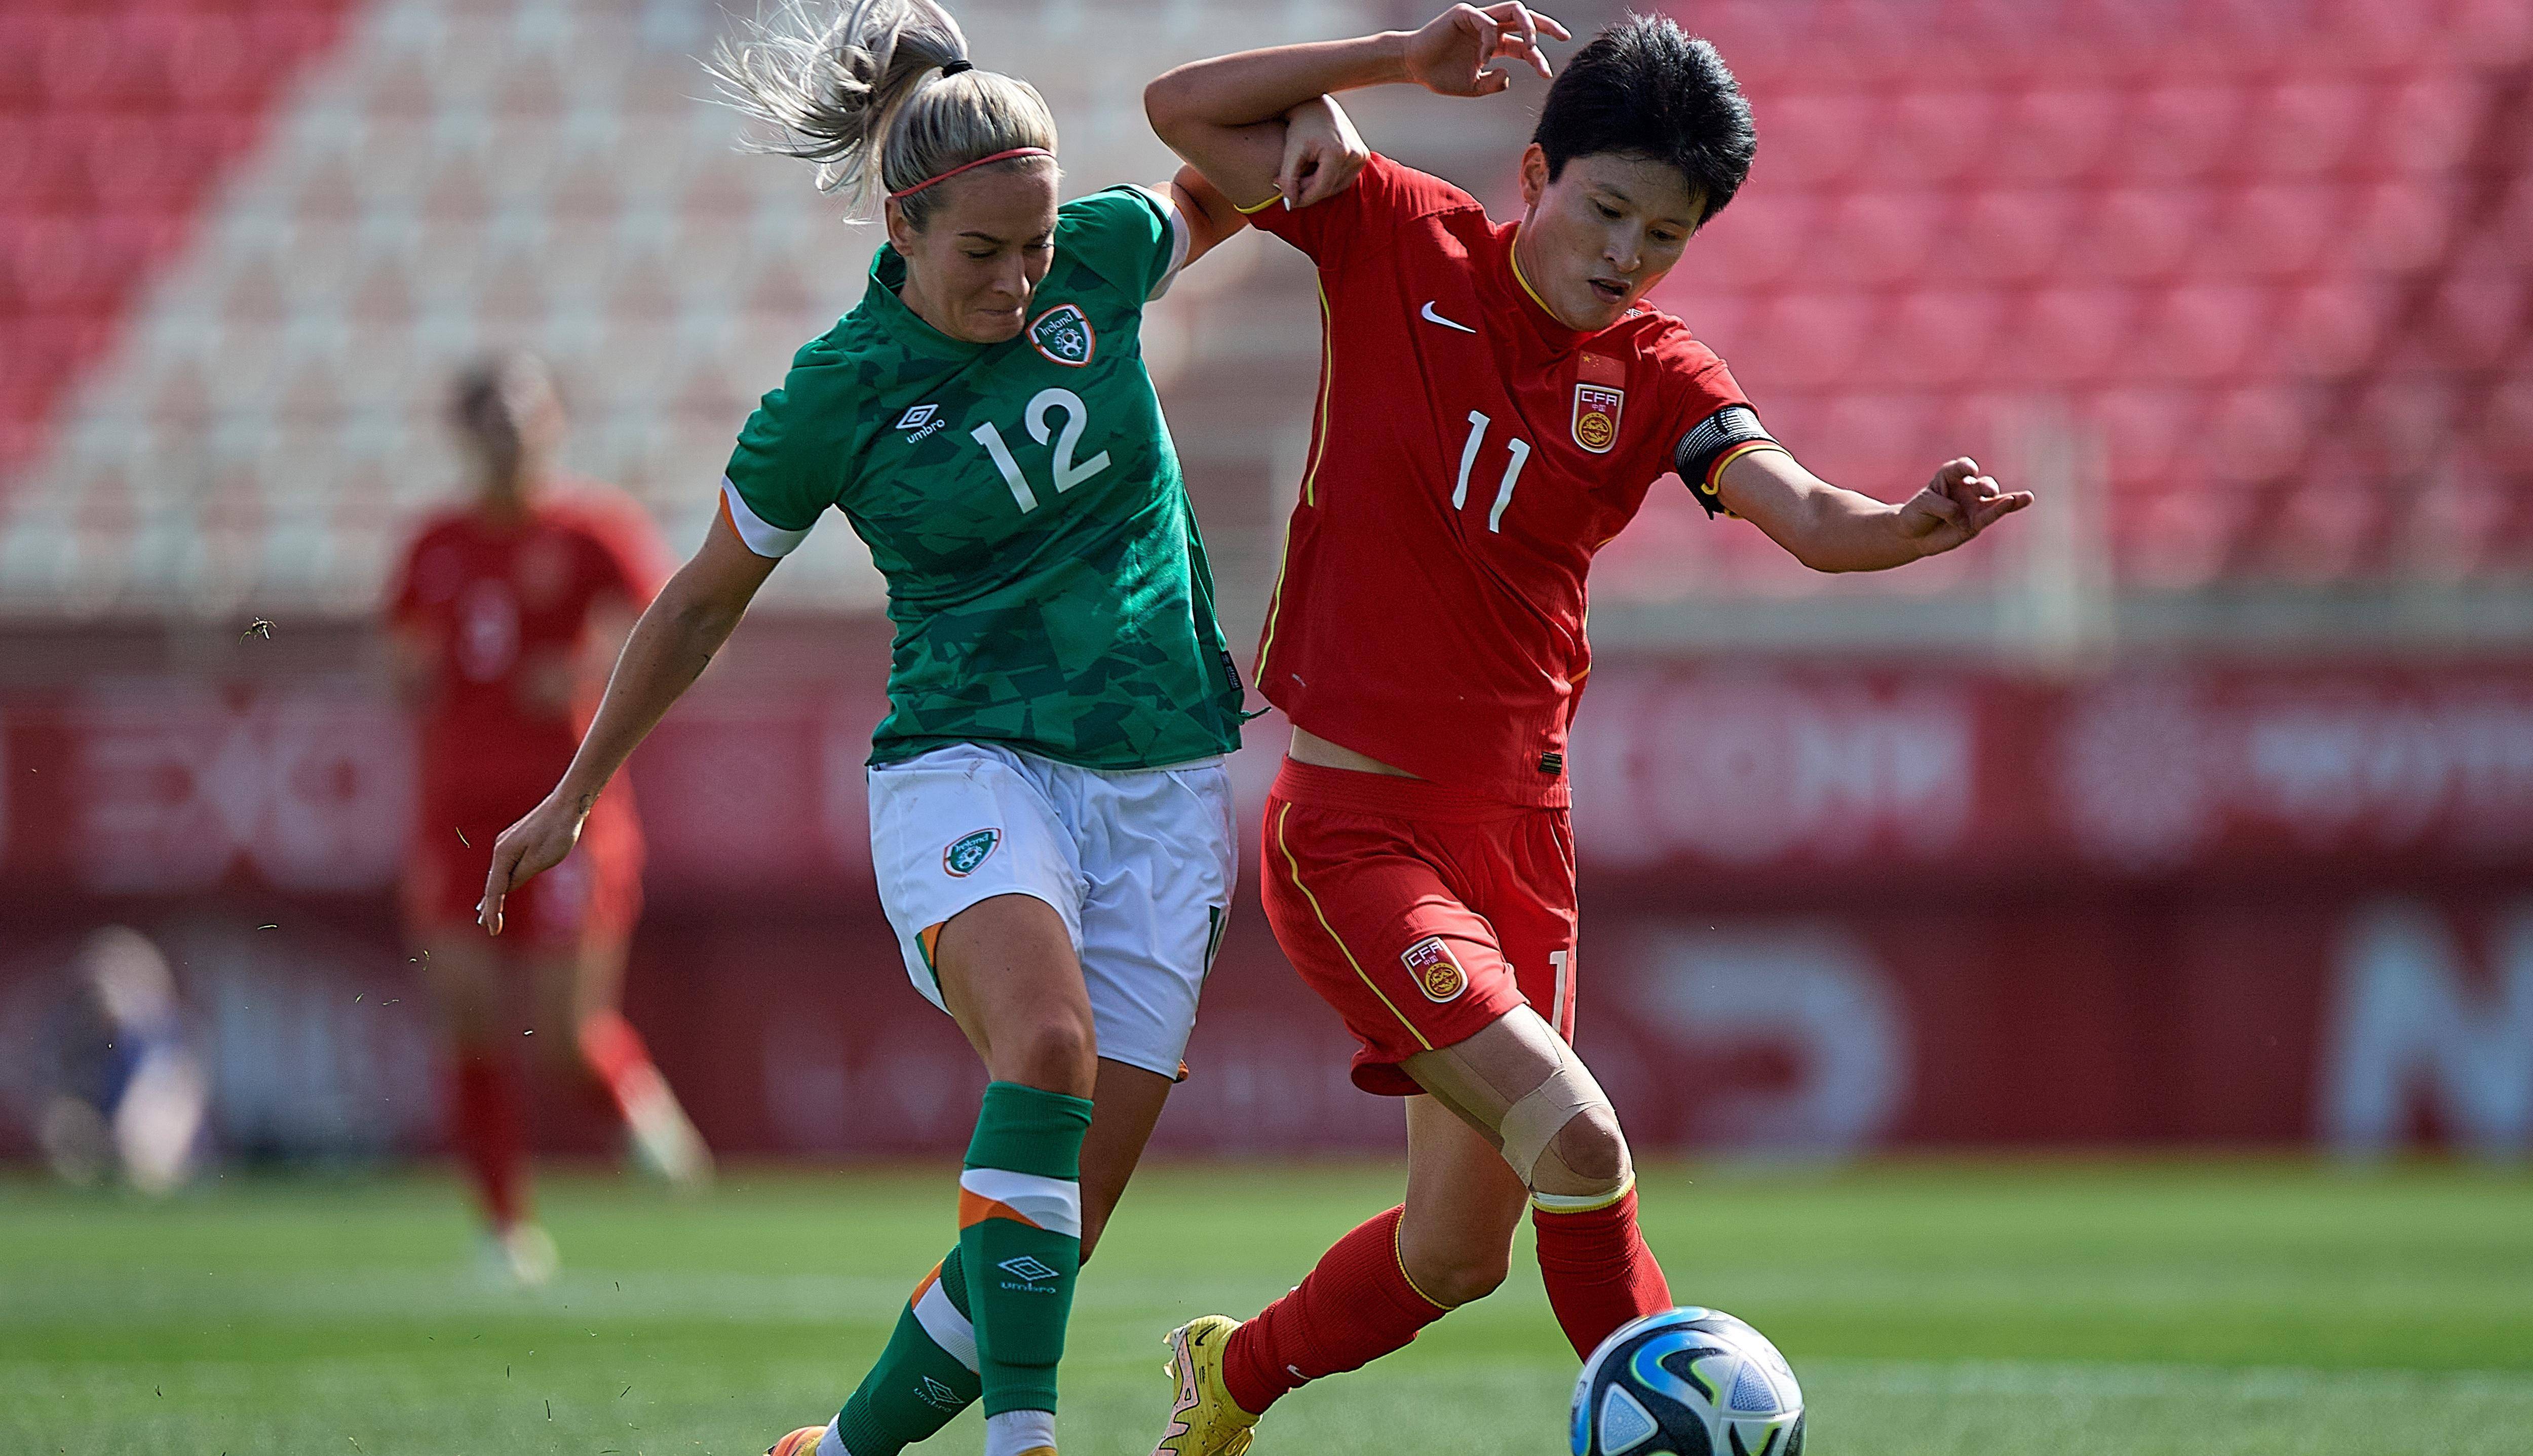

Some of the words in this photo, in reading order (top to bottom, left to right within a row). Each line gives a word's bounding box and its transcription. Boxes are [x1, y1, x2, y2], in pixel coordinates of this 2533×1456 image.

[1038, 311, 1073, 336] Ireland
[1581, 390, 1618, 406] CFA
[1592, 404, 1606, 412] 中国
[906, 419, 945, 444] umbro
[970, 388, 1111, 515] 12
[1452, 410, 1530, 533] 11
[955, 834, 988, 852] Ireland
[1407, 941, 1443, 967] CFA
[1424, 955, 1438, 965] 中国
[1001, 1282, 1056, 1294] umbro
[914, 1388, 951, 1412] umbro
